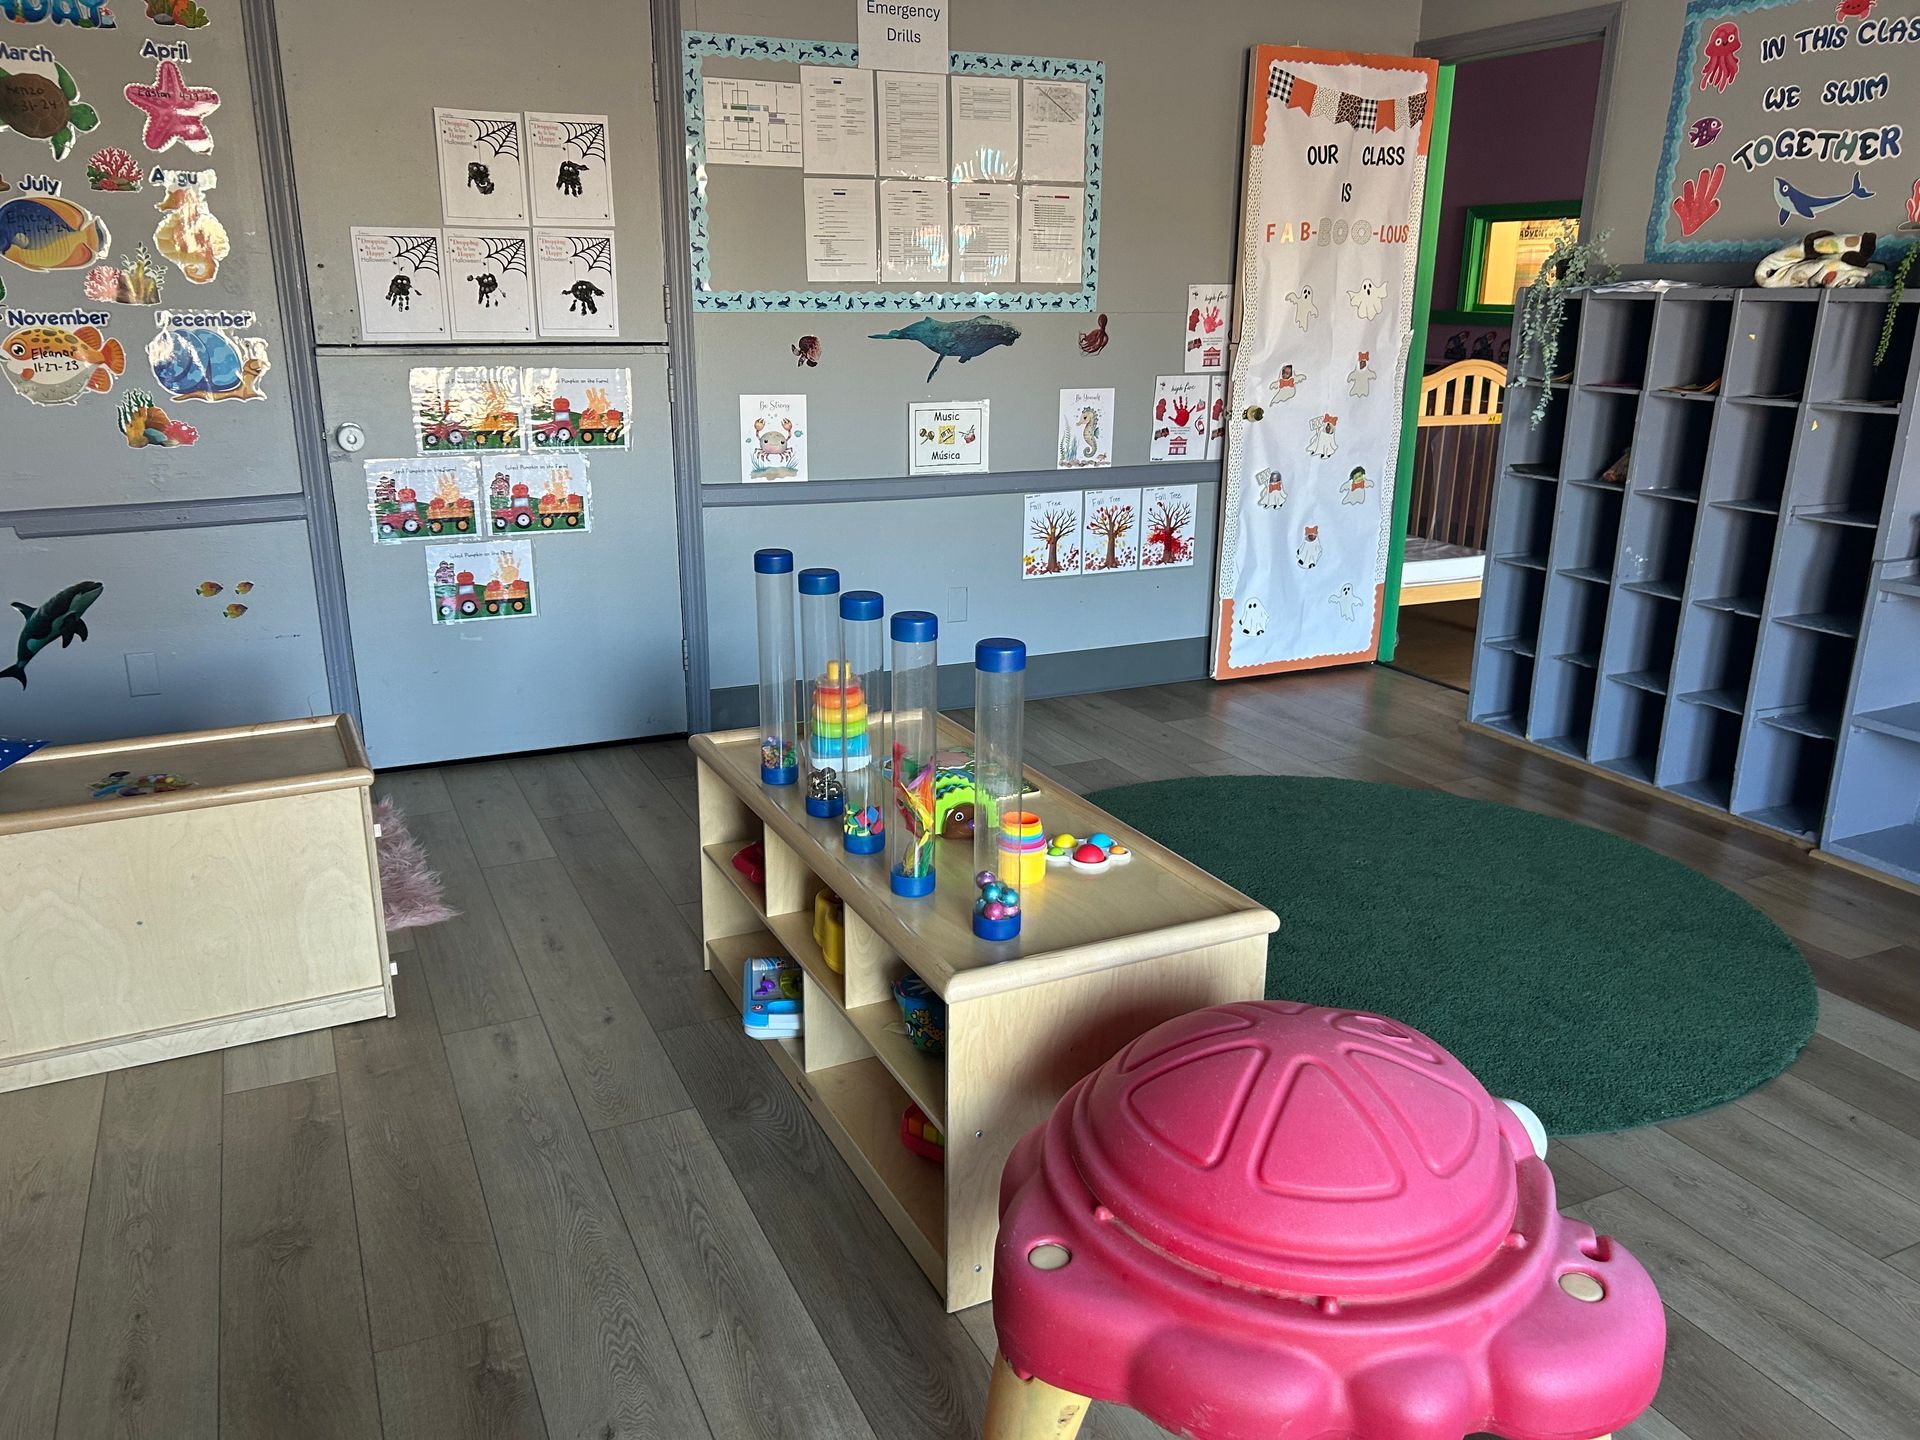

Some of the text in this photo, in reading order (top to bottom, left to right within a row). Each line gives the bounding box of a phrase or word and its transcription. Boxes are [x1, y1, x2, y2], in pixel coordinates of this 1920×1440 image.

[867, 0, 940, 21] Emergency
[887, 28, 921, 43] Drills
[1763, 38, 1785, 61] IN
[1796, 27, 1848, 52] THIS
[143, 41, 188, 61] April
[1765, 75, 1888, 110] WE SWIM
[1307, 144, 1406, 166] OUR CLASS
[1733, 126, 1901, 171] TOGETHER
[20, 175, 59, 195] July
[1341, 182, 1353, 203] IS
[8, 310, 108, 326] November
[31, 347, 75, 360] Eleanor
[934, 410, 960, 421] Music
[931, 450, 960, 460] Música
